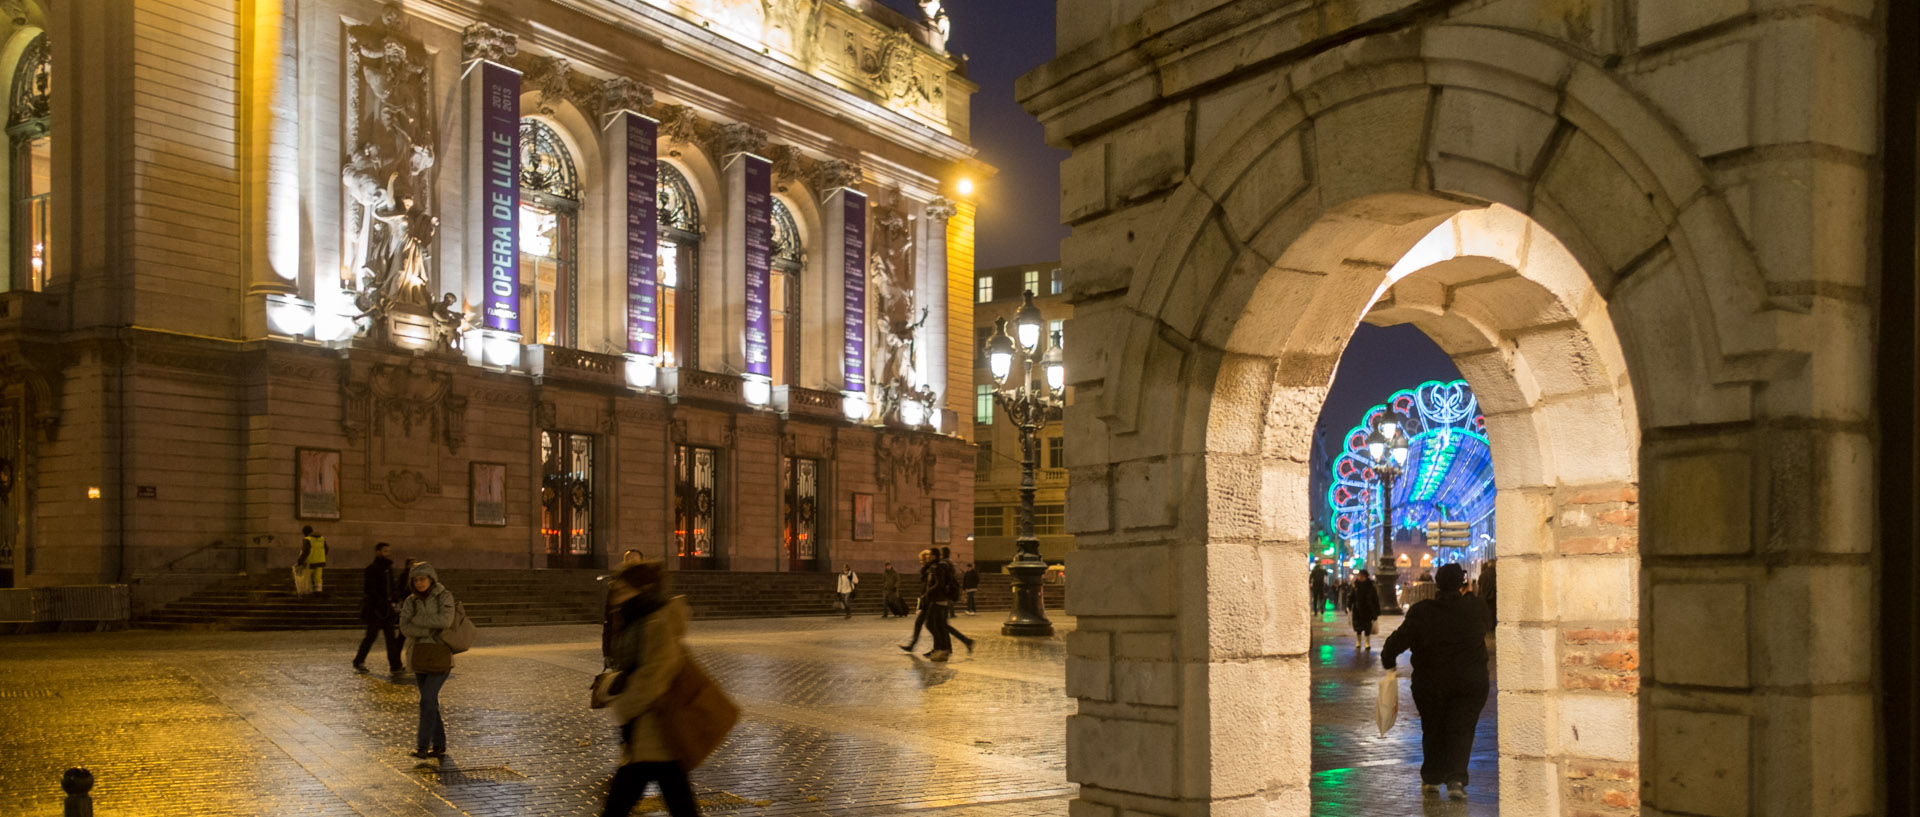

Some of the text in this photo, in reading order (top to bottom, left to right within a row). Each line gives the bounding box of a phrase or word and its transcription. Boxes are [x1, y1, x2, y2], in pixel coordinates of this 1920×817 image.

[492, 84, 502, 109] 2012
[503, 88, 512, 112] 2013
[492, 131, 511, 188] LILLE
[492, 195, 511, 221] DE
[492, 228, 512, 297] OPERA
